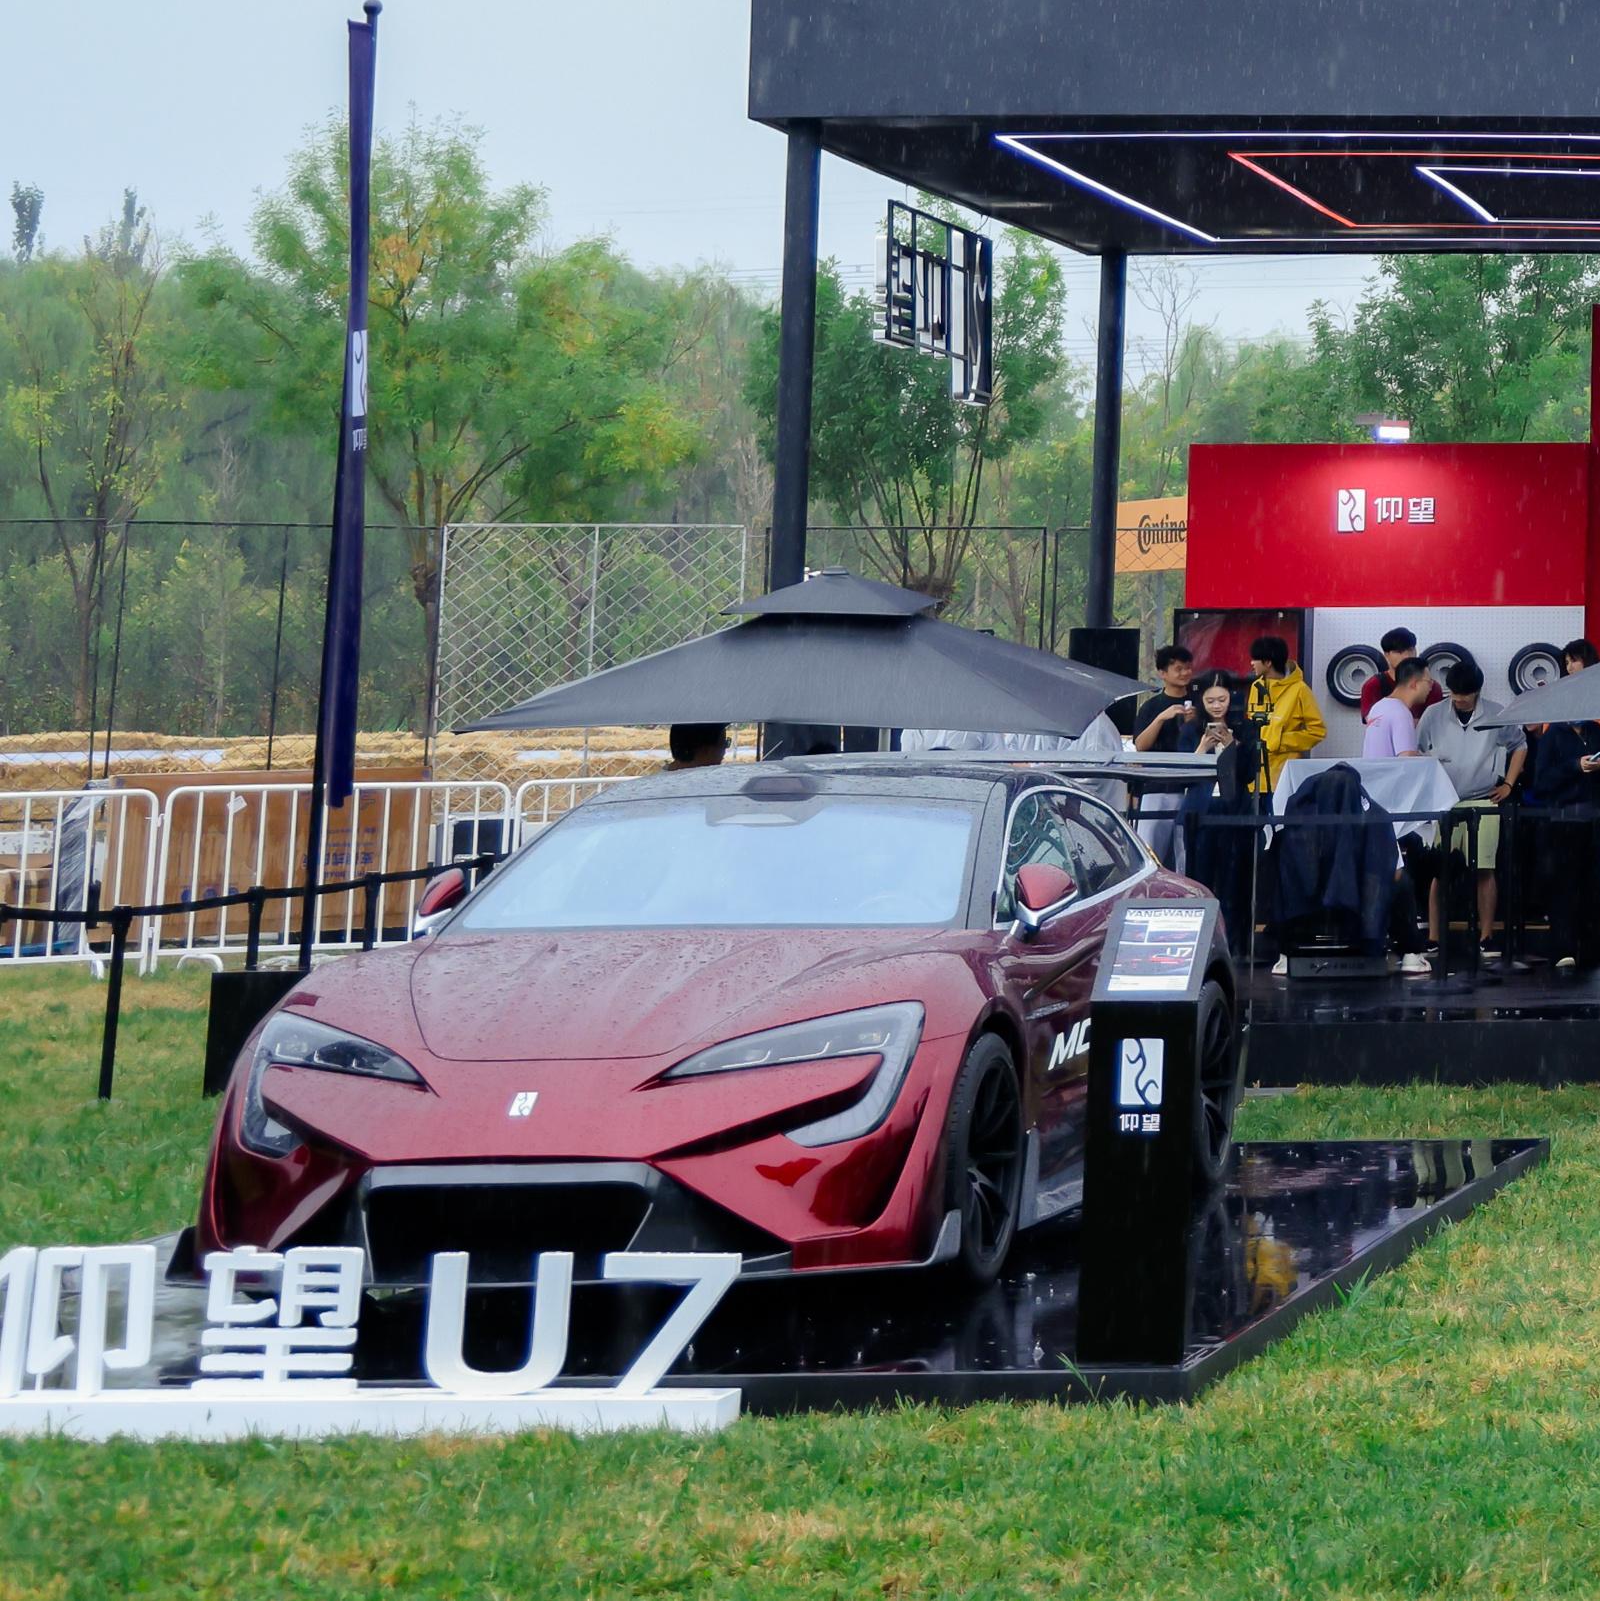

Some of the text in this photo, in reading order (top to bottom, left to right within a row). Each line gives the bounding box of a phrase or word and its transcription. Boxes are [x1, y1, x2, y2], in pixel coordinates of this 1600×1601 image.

[1373, 497, 1435, 523] 仰望
[1126, 909, 1203, 918] YANGWANG
[1166, 946, 1193, 958] U7
[1119, 1113, 1161, 1132] 仰望
[0, 1246, 742, 1396] 仰望 U7
